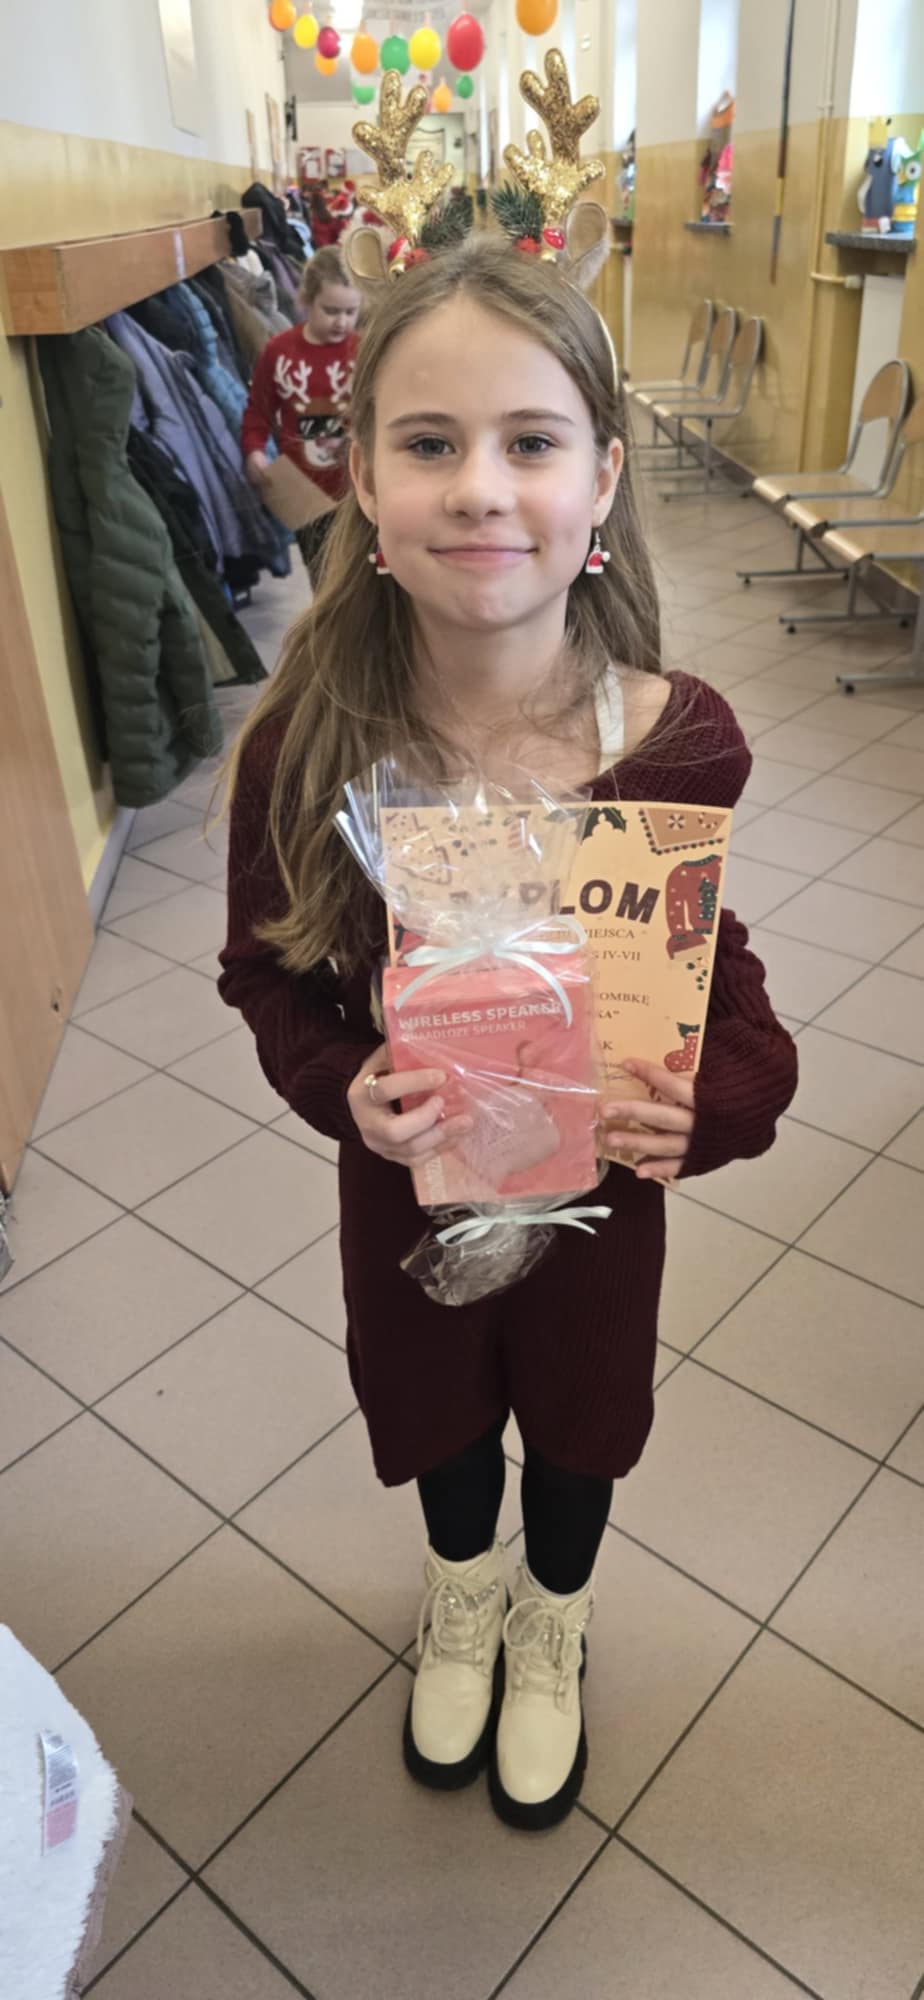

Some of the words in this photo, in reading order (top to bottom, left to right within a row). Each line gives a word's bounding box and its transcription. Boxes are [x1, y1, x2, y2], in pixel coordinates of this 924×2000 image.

[399, 1010, 483, 1030] WIRELESS
[485, 1002, 561, 1021] SPEAKER
[472, 1020, 527, 1036] SPEAKER
